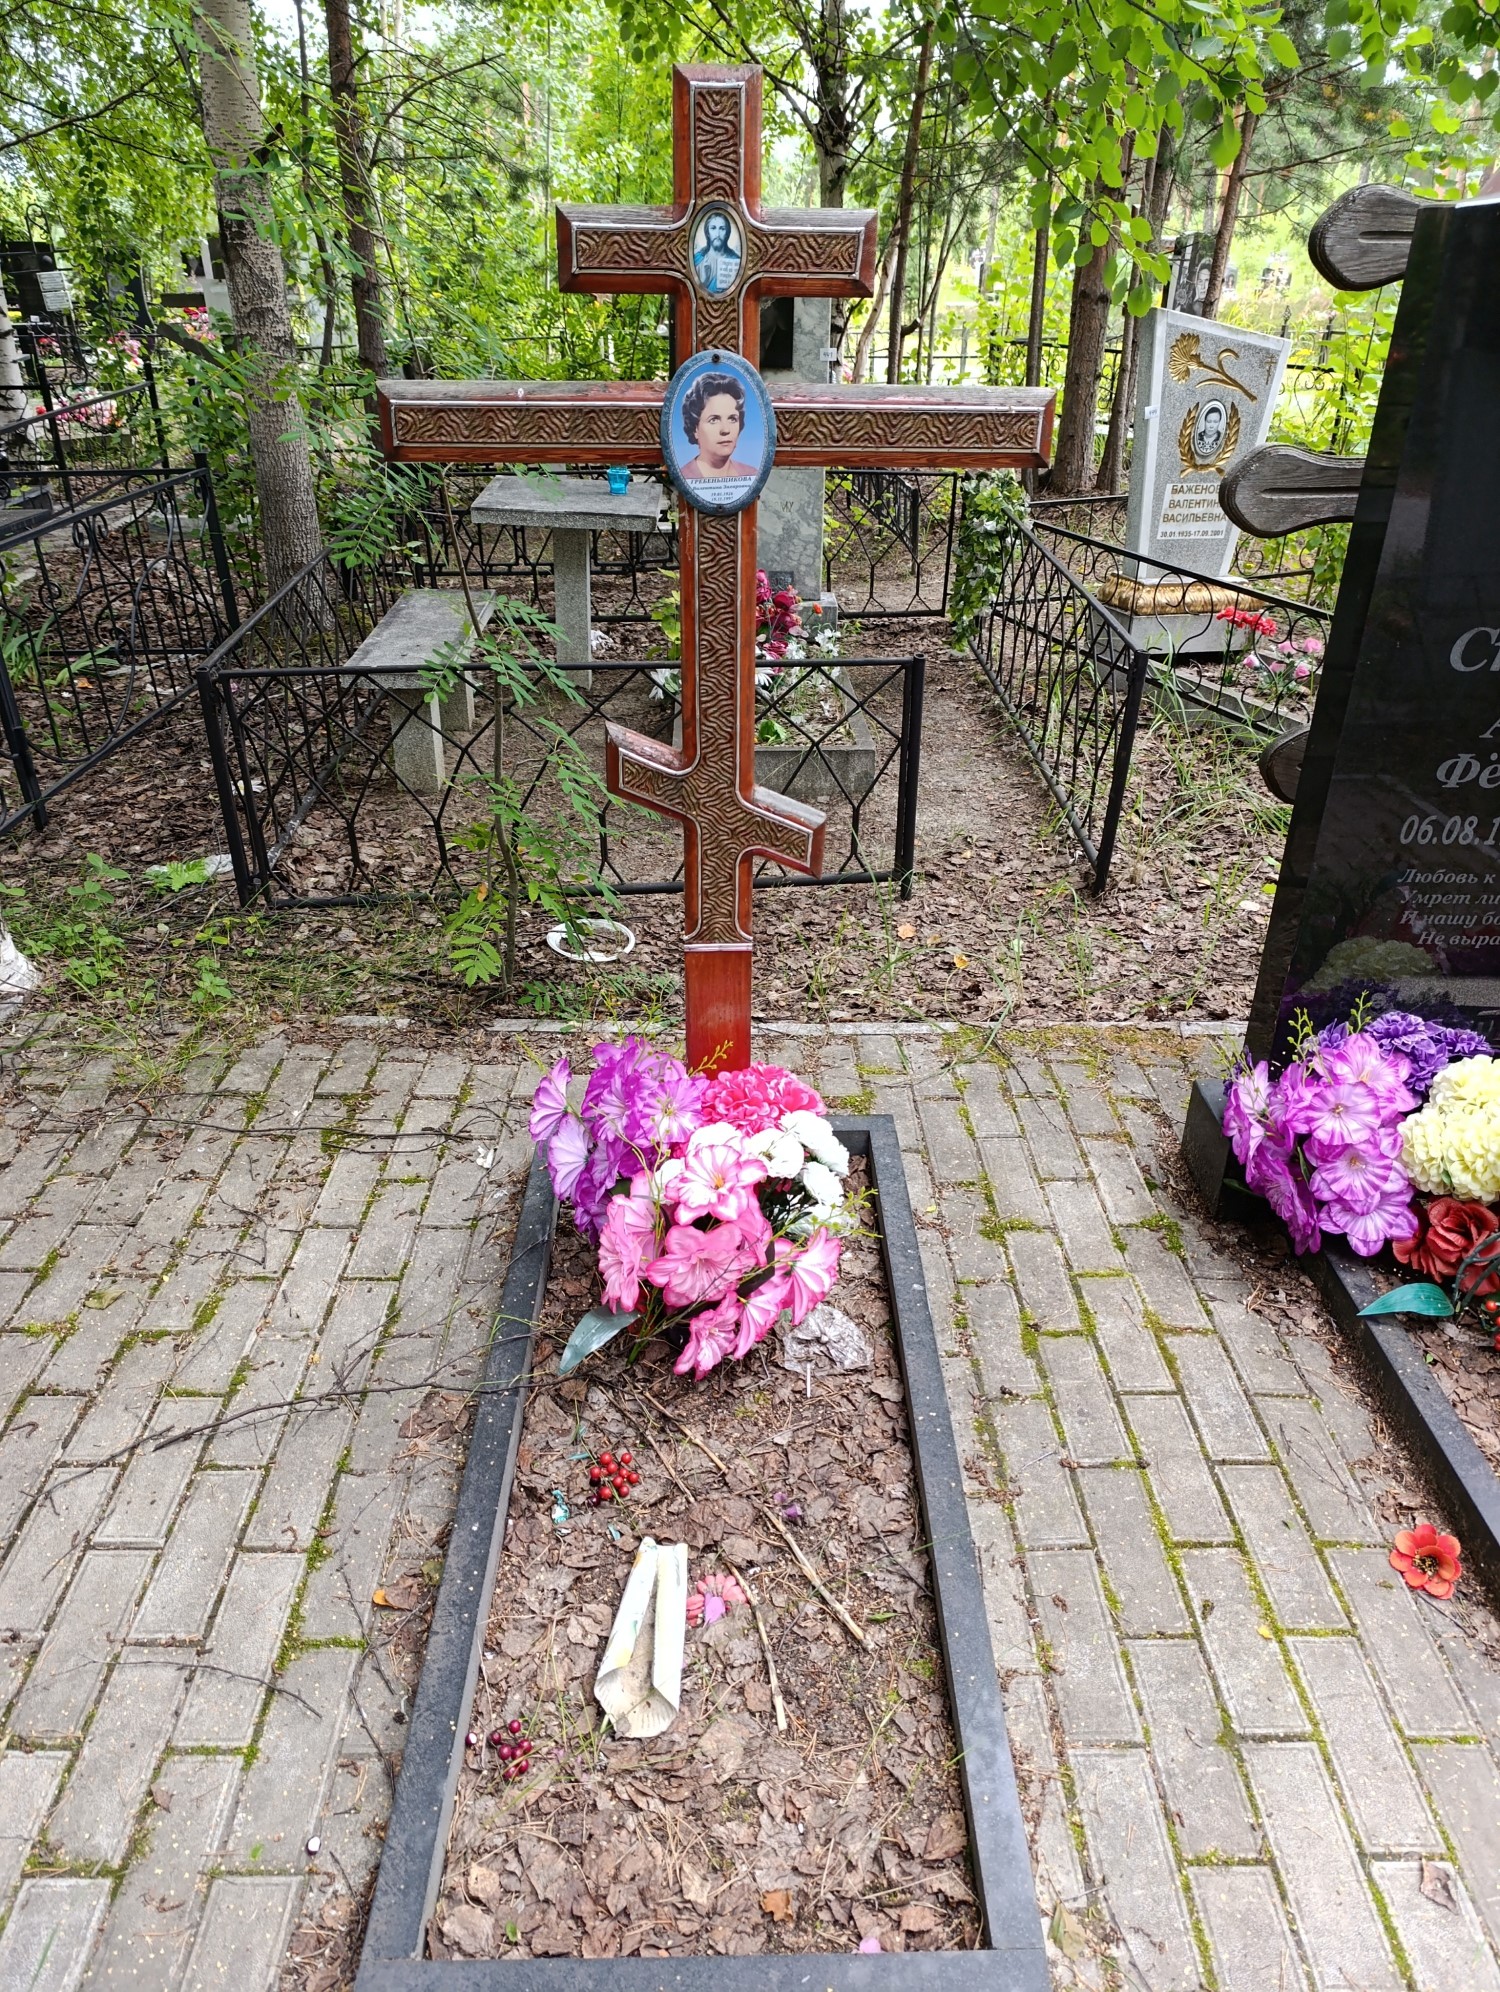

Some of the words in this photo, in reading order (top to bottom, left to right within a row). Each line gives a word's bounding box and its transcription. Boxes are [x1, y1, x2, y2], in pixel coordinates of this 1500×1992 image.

[1162, 512, 1227, 523] ВАСИЛЬЕВНА
[1397, 868, 1479, 884] Любовь
[1483, 873, 1496, 884] к
[1400, 889, 1471, 908] Умрет
[1423, 913, 1478, 929] нашу
[1417, 931, 1446, 946] Не
